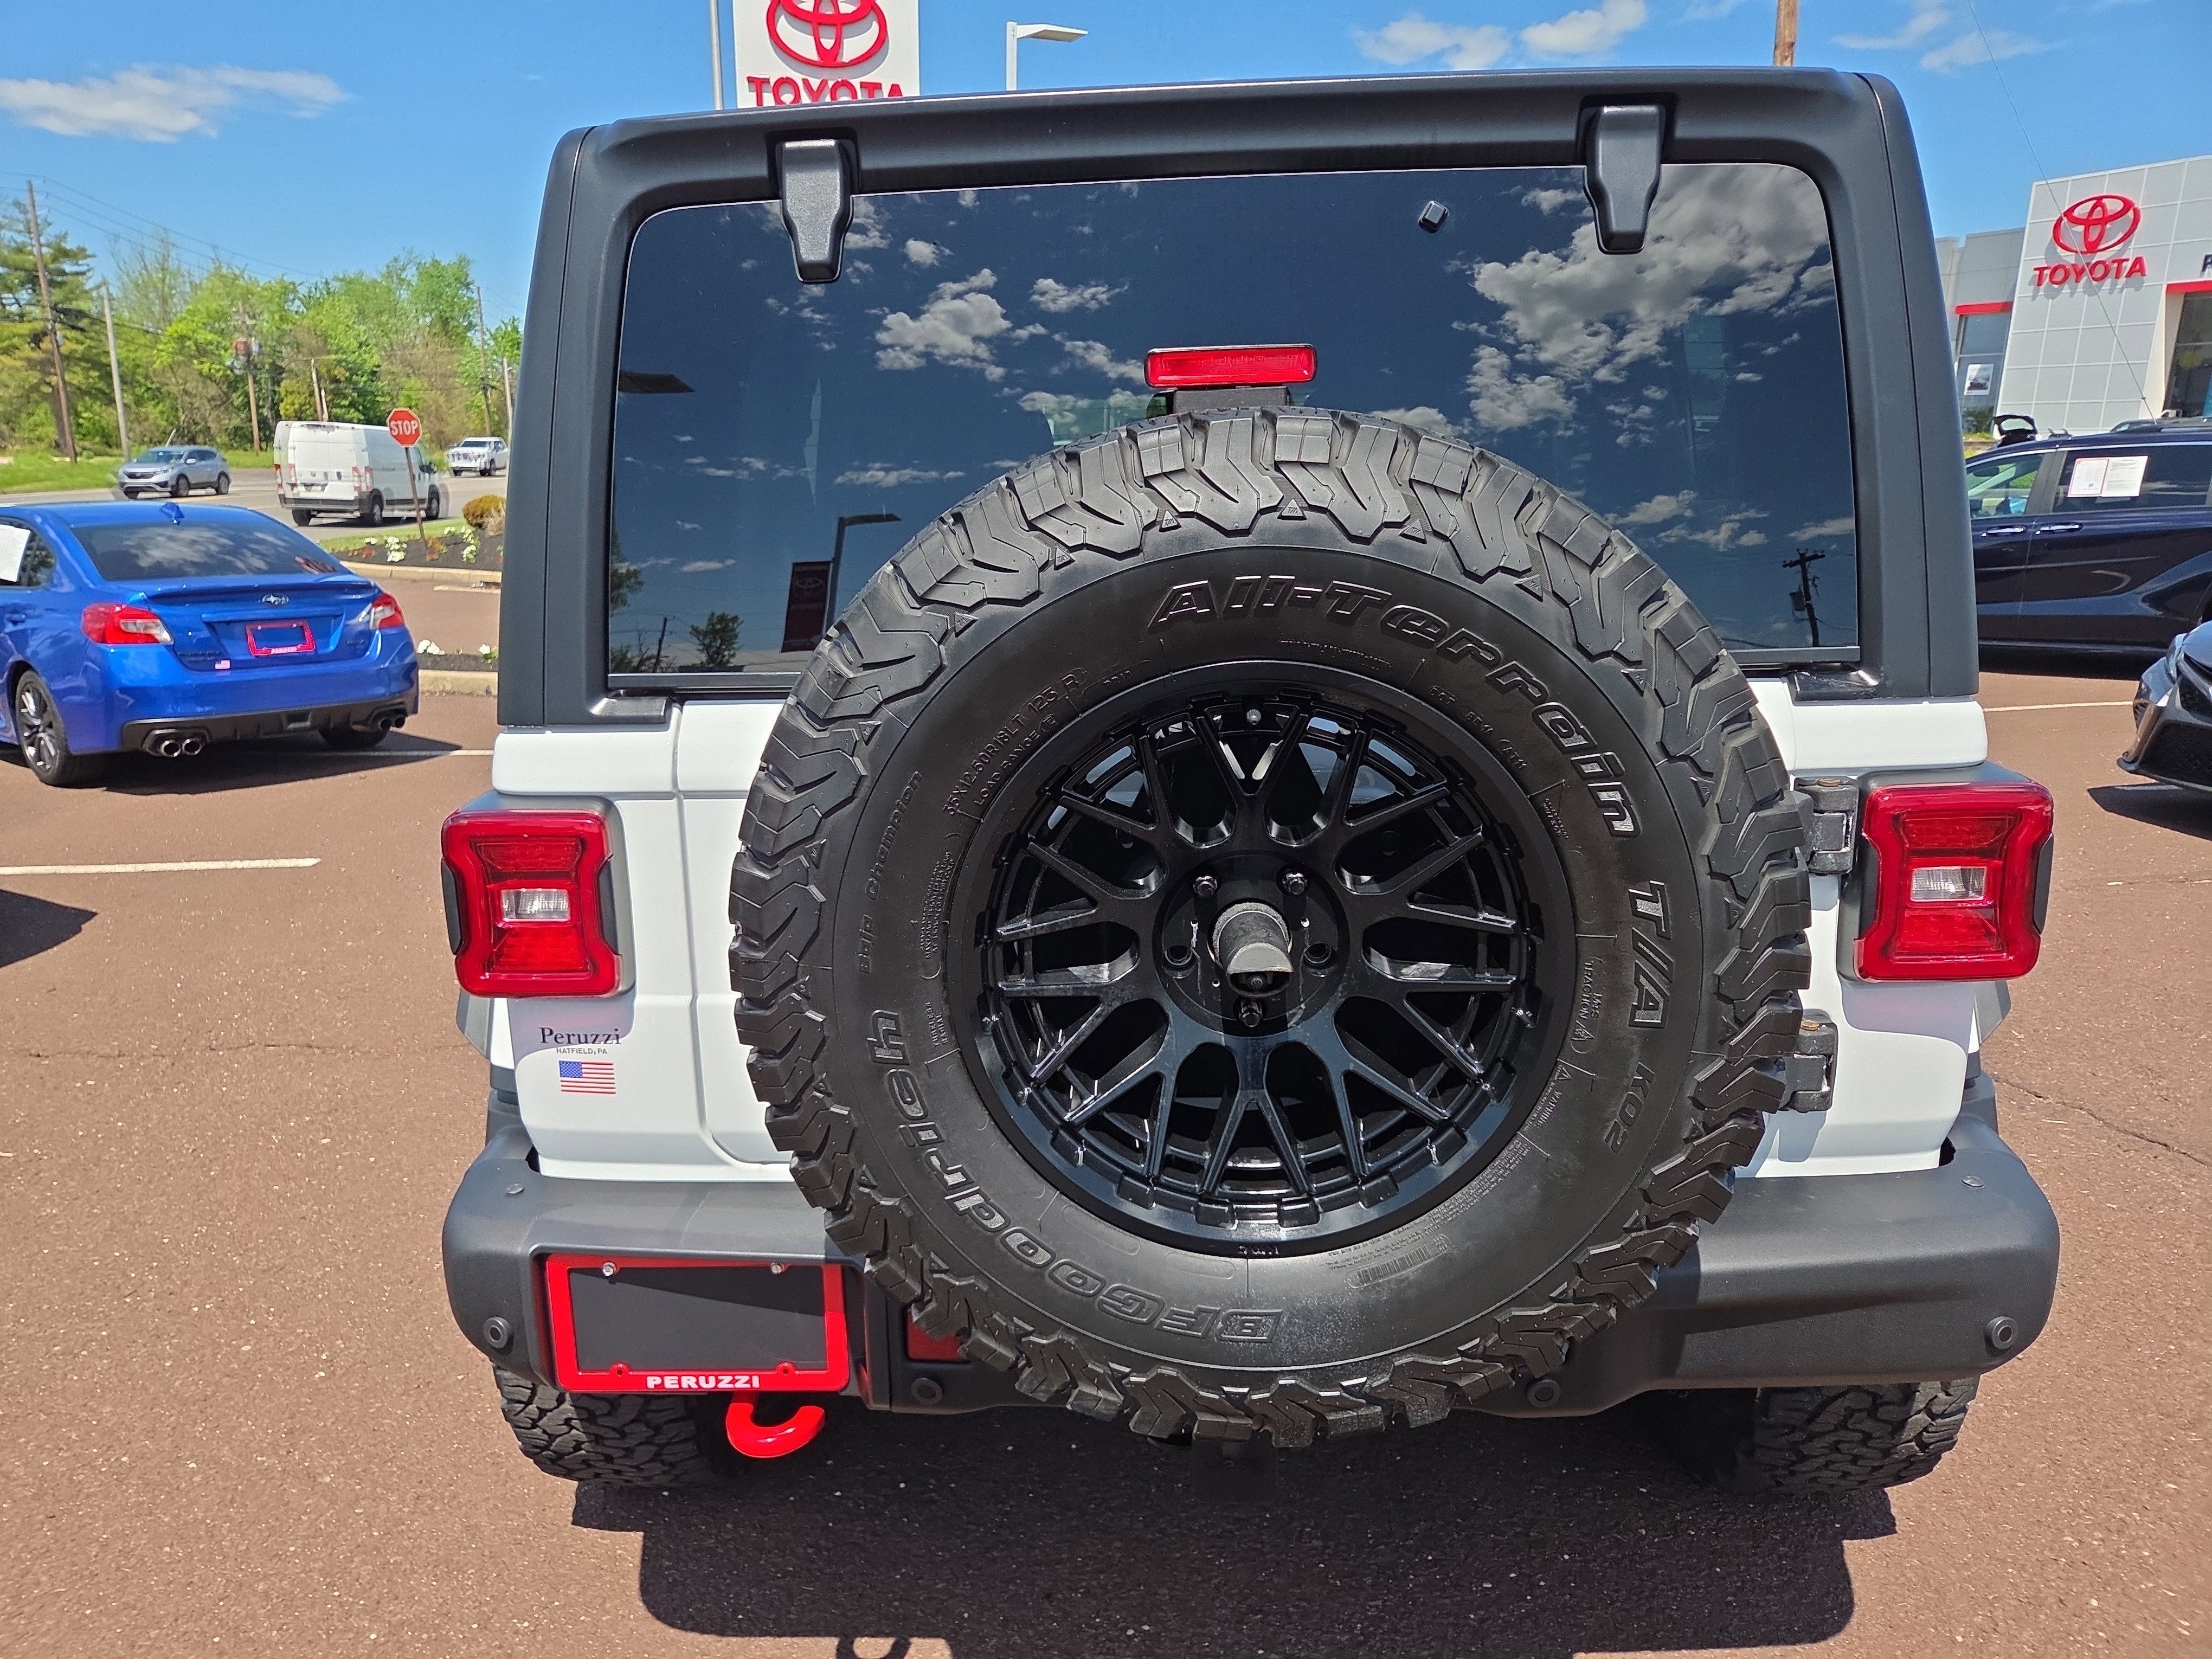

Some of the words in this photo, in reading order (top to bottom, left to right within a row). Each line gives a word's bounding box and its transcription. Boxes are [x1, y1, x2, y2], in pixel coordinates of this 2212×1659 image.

[2034, 256, 2147, 286] TOYOTA
[390, 420, 419, 435] STOP
[974, 771, 1002, 806] LOAD
[1000, 730, 1040, 769] RANGE
[1628, 880, 1674, 1029] T/A
[1580, 960, 1594, 1020] TRACTION
[539, 1026, 622, 1045] Peruzzi
[556, 1047, 596, 1055] HATFIELD,
[1604, 1062, 1655, 1153] KO2
[867, 1009, 1283, 1343] BFGoodrich
[645, 1375, 760, 1390] PERUZZI
